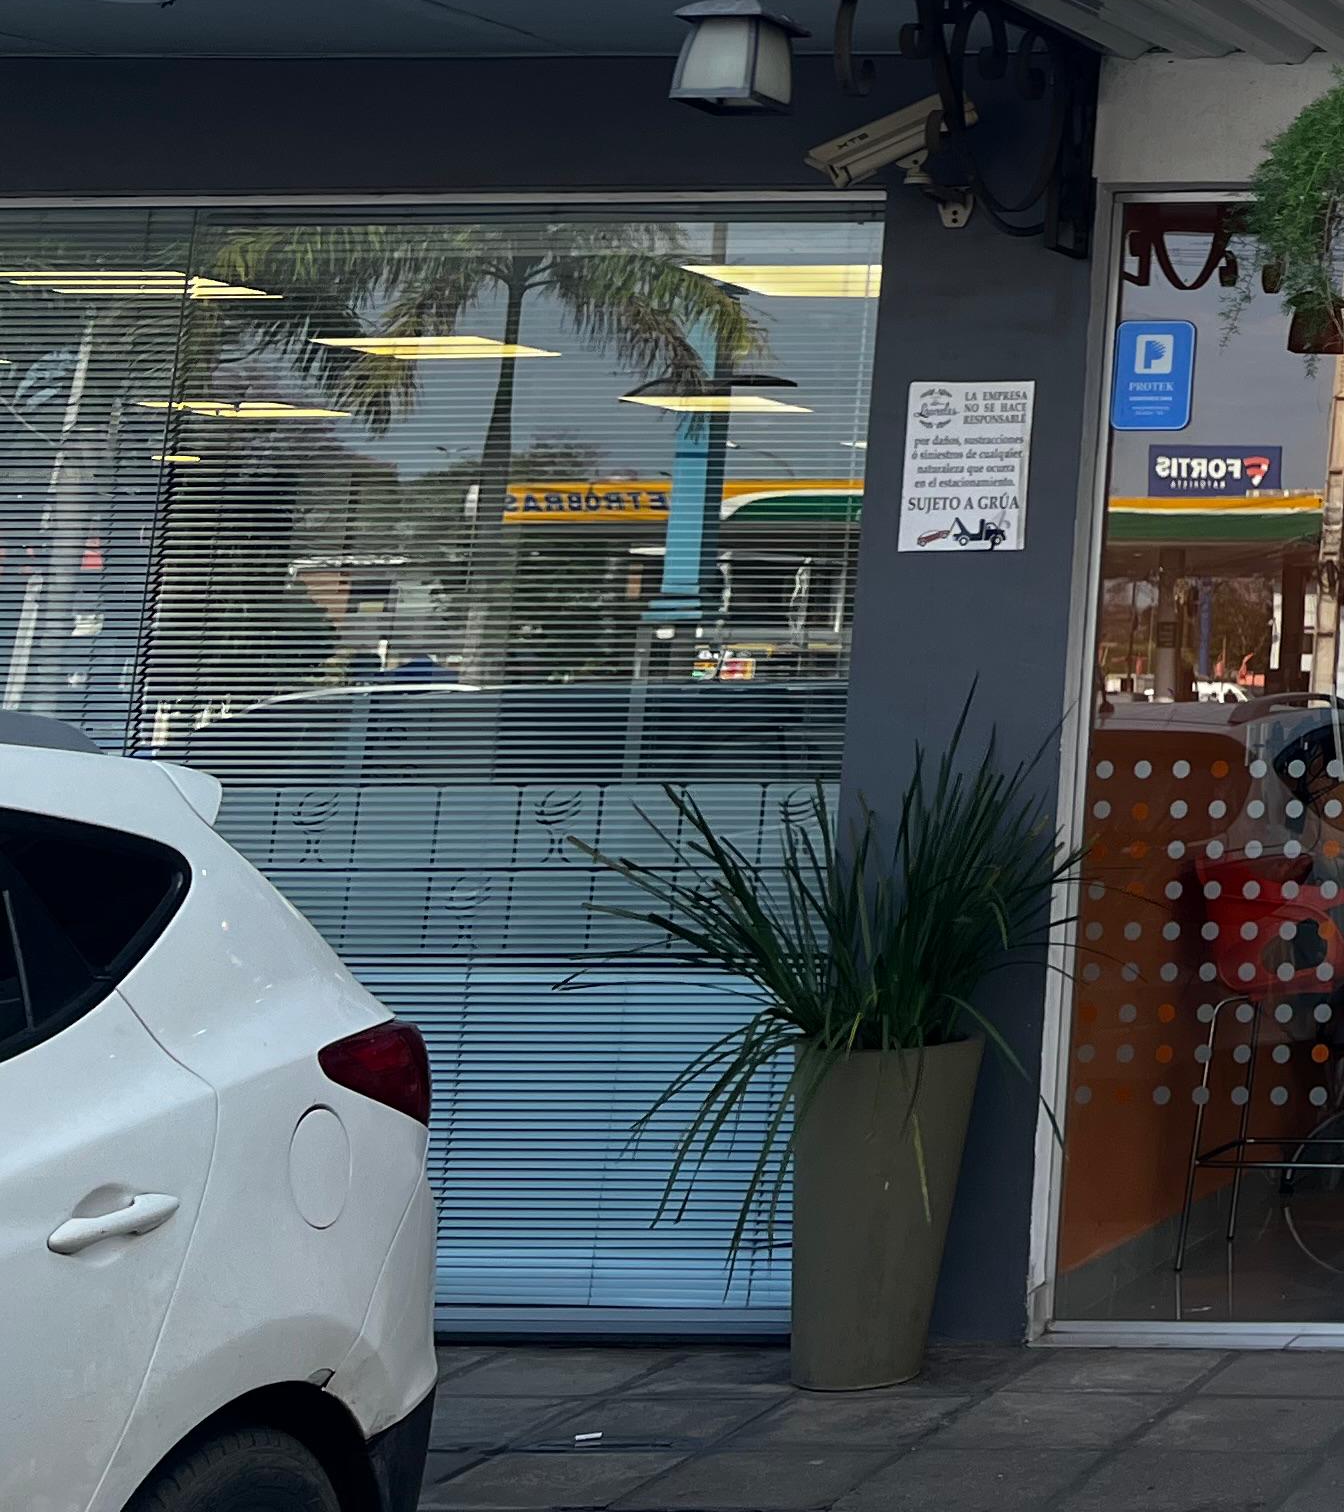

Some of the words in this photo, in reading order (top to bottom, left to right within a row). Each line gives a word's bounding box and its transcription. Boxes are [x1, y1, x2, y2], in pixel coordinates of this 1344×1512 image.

[1129, 381, 1174, 392] PROTEK
[964, 391, 977, 401] LA
[982, 390, 1028, 401] EMPRESA
[964, 403, 979, 413] NO
[1000, 402, 1027, 413] HACE
[963, 414, 1026, 425] RESPONSABLE
[908, 496, 961, 514] SUJETO
[964, 497, 974, 510] A
[978, 492, 1020, 510] GRÚA
